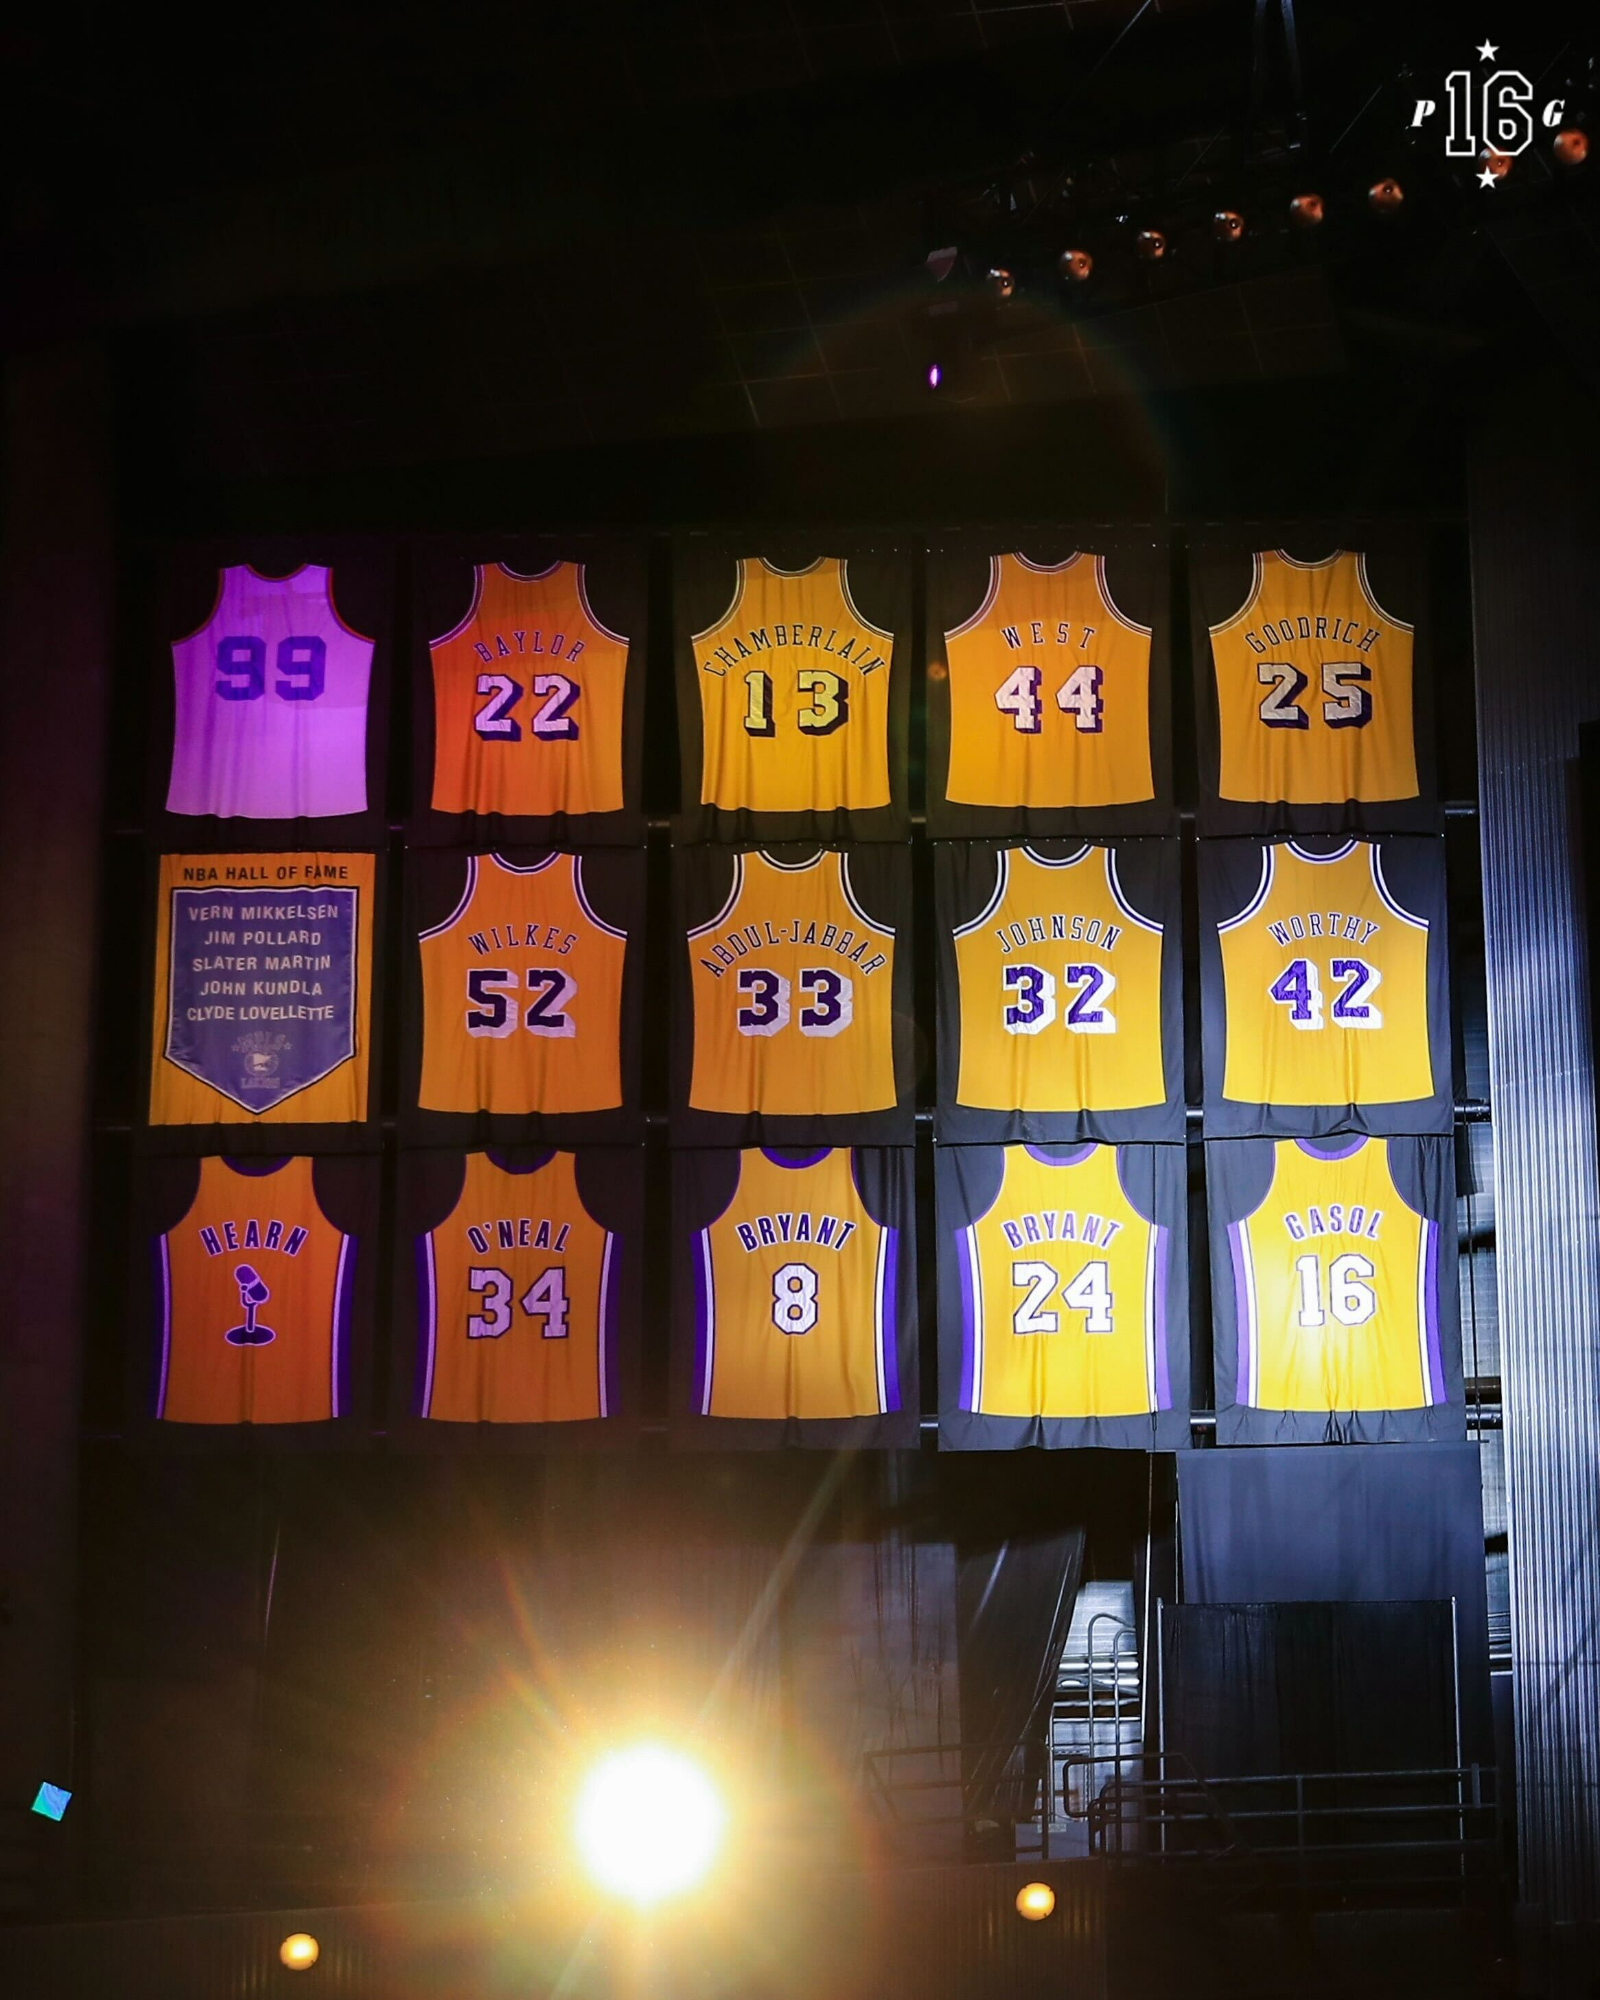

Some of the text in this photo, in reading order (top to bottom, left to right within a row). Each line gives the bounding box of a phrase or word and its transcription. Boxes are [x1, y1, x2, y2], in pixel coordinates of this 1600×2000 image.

[474, 631, 585, 664] BAYLOR
[704, 623, 886, 678] CHAMBERLAIN
[1001, 622, 1097, 651] WEST
[1245, 616, 1381, 654] GOODRICH
[216, 636, 326, 701] 99
[473, 674, 581, 741] 22
[743, 665, 849, 738] 13
[994, 665, 1104, 734] 44
[1256, 661, 1372, 729] 25
[184, 866, 348, 881] NBA HALL OF FAME
[188, 904, 338, 921] VERN MIKKELSEN
[1266, 912, 1381, 947] WORTHY
[204, 930, 321, 945] JIM POLLARD
[467, 924, 577, 956] WILKES
[700, 920, 889, 978] ABDUL-JABBAR
[996, 914, 1124, 953] JOHNSON
[192, 955, 331, 972] SLATER MARTIN
[201, 980, 322, 996] JOHN KUNDLA
[466, 968, 577, 1038] 52
[737, 967, 853, 1037] 33
[1002, 963, 1116, 1035] 32
[1267, 957, 1382, 1030] 42
[187, 1005, 334, 1021] CLYDE LOVELLETTE
[199, 1219, 309, 1257] HEARN
[466, 1218, 572, 1255] O'NEAL
[735, 1212, 857, 1252] BRYANT
[1000, 1209, 1123, 1251] BRYANT
[1284, 1203, 1382, 1242] GASOL
[467, 1266, 570, 1339] 34
[771, 1262, 820, 1336] 8
[1011, 1260, 1113, 1335] 24
[1295, 1253, 1376, 1328] 16
